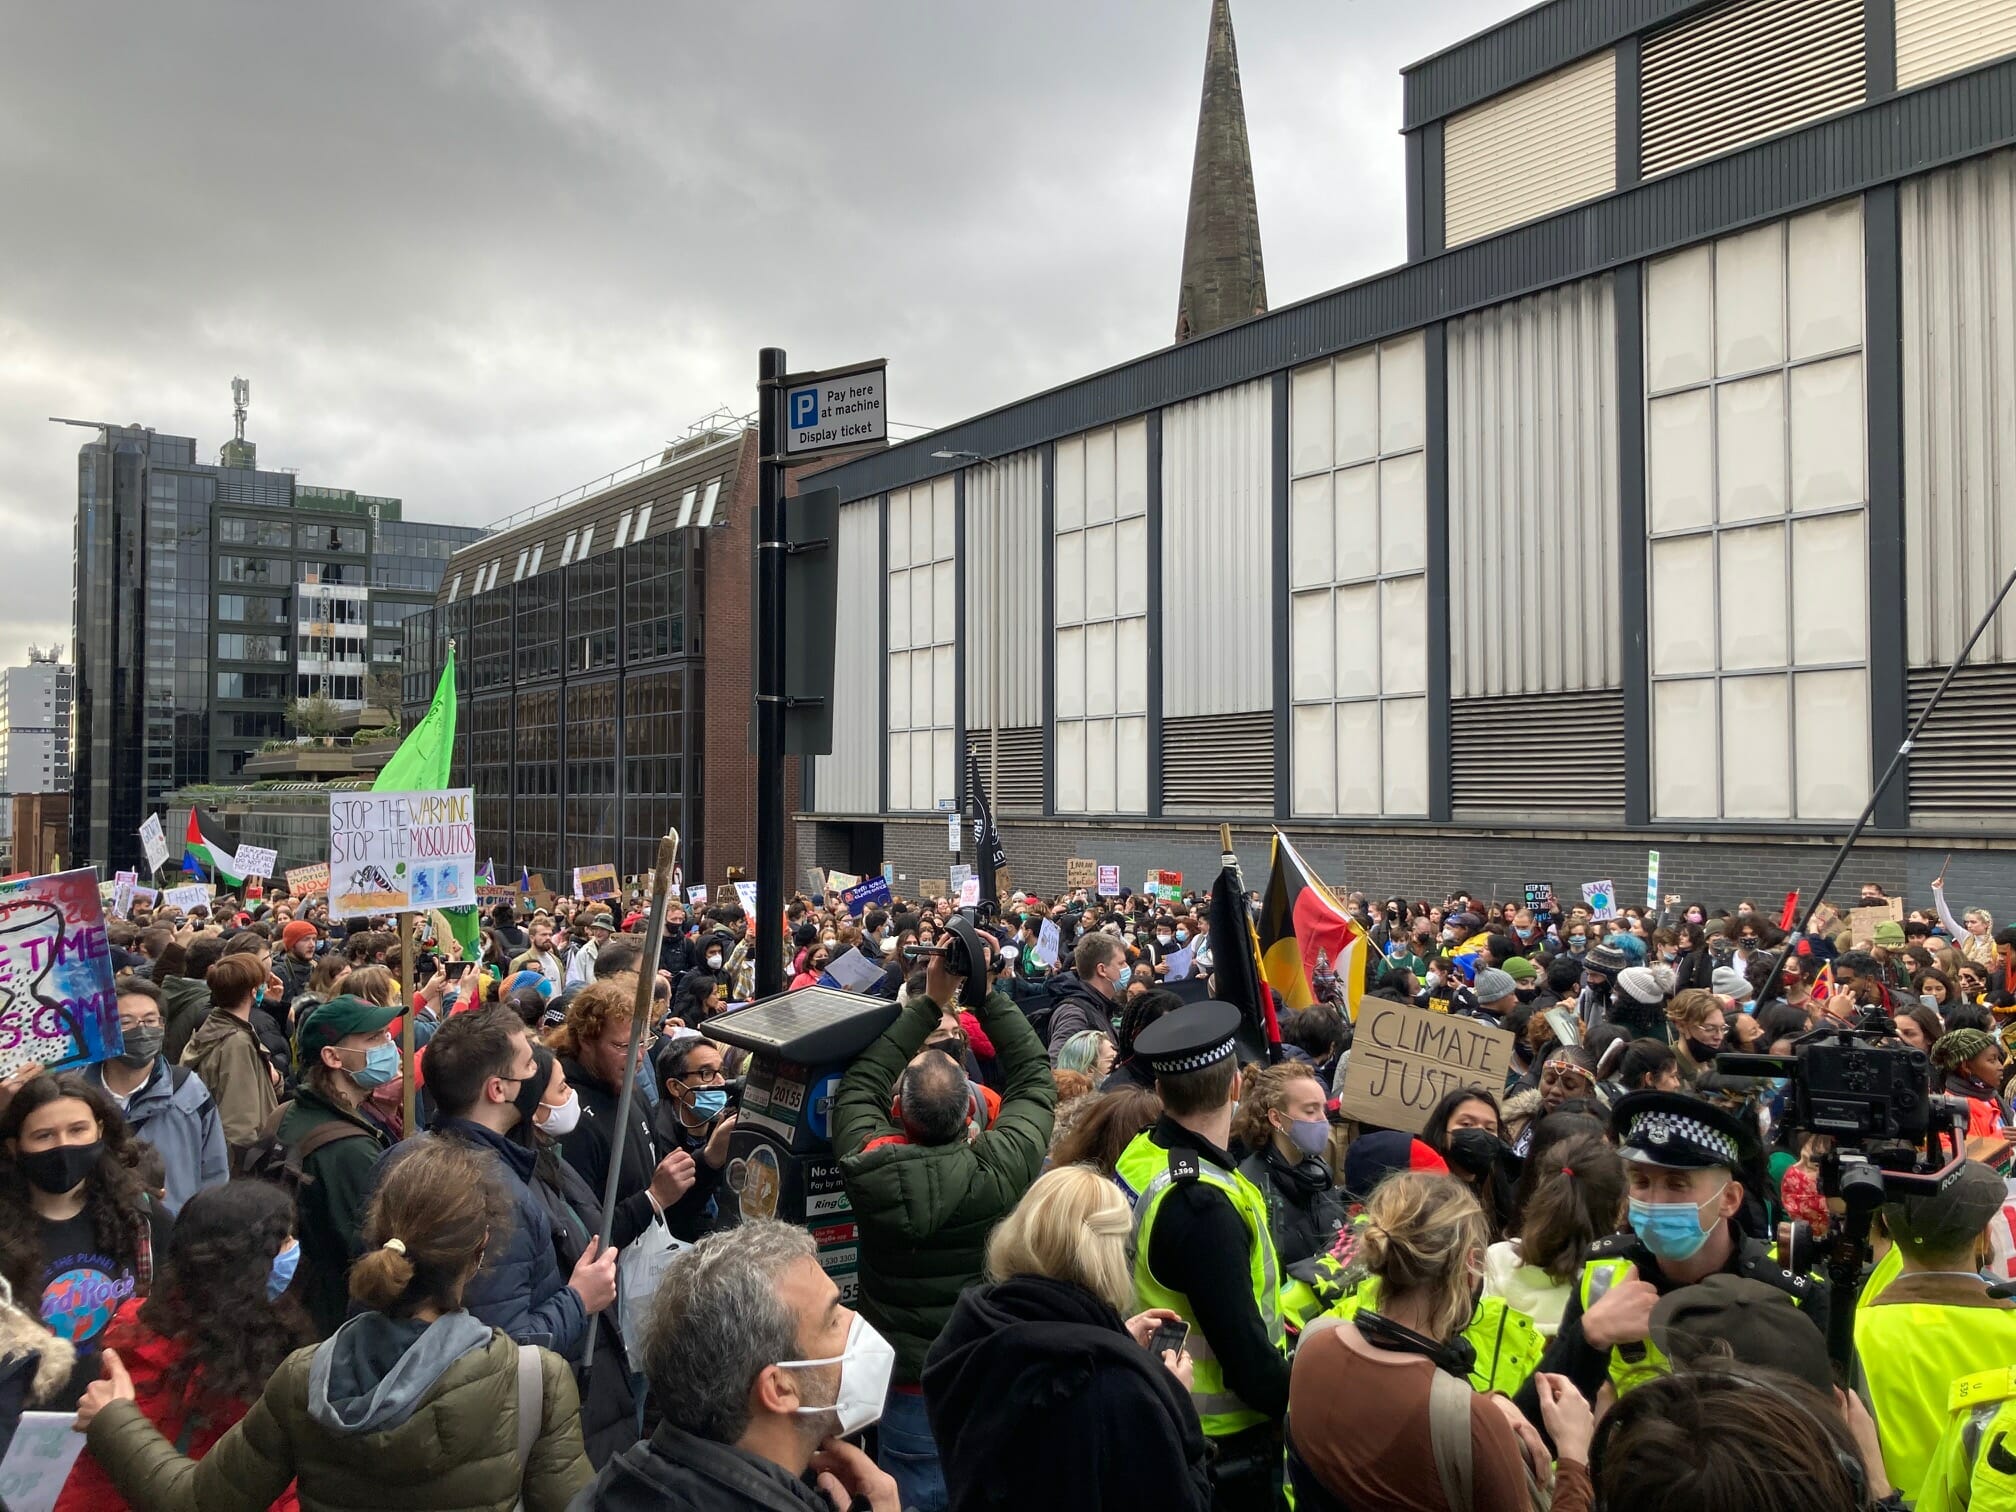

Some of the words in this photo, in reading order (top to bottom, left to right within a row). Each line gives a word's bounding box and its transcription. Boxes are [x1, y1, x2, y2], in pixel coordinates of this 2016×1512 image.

[827, 390, 846, 402] Pay
[849, 386, 873, 398] here
[821, 408, 832, 418] at
[835, 399, 880, 415] machine
[800, 429, 837, 444] Display
[841, 422, 872, 438] ticket
[332, 800, 373, 831] STOP
[378, 799, 406, 828] THE
[407, 795, 470, 825] WARMING
[332, 831, 374, 863] STOP
[378, 828, 407, 859] THE
[410, 822, 475, 857] MOSQUITOS
[288, 864, 325, 878] CLIMATE
[290, 871, 329, 885] JUSTICE
[296, 879, 329, 893] NOW
[477, 887, 504, 895] RESPECT
[1584, 884, 1612, 896] WAKE
[1593, 908, 1612, 919] UP!
[20, 926, 109, 972] TIME
[32, 990, 120, 1037] COME
[1371, 1011, 1500, 1072] CLIMATE
[774, 1087, 802, 1108] 20155
[811, 1167, 827, 1177] No
[1173, 1167, 1194, 1176] 1399
[811, 1181, 823, 1190] Pay
[826, 1180, 833, 1188] by
[825, 1255, 838, 1266] 530
[840, 1253, 856, 1263] 3303
[1960, 1382, 1968, 1397] 530
